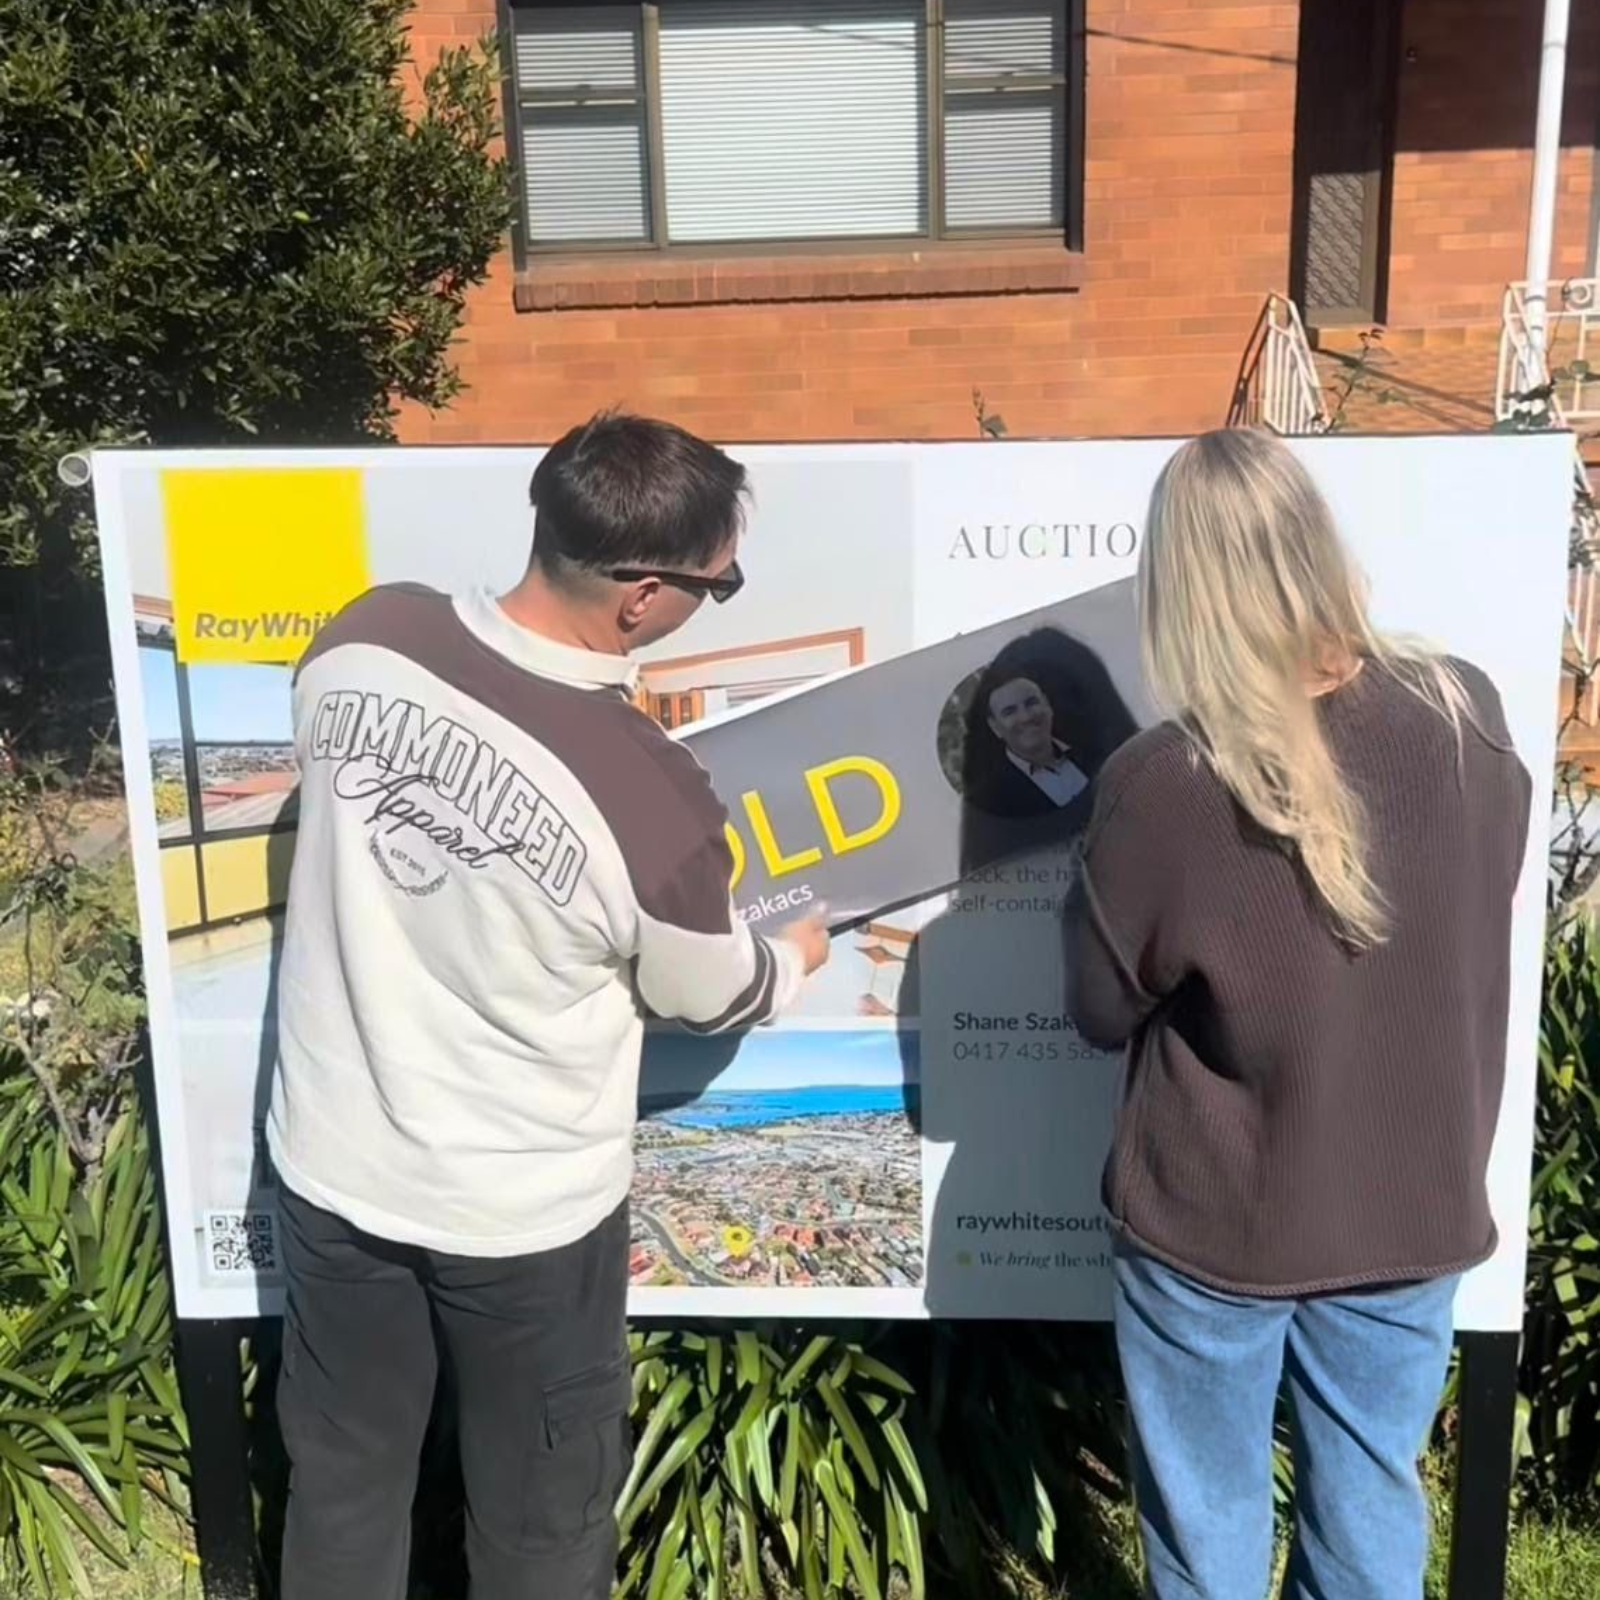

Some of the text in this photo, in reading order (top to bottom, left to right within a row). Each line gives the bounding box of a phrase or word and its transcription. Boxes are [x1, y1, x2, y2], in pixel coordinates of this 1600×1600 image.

[948, 522, 1138, 560] AUCTIO
[333, 752, 524, 869] Apparel
[724, 755, 902, 890] LD
[1017, 864, 1049, 884] the
[735, 883, 815, 923] zakacs
[952, 894, 1060, 913] self-contai
[952, 1011, 1080, 1031] Shane Szak
[953, 1041, 1010, 1061] 0417
[1016, 1041, 1059, 1061] 435
[1007, 1250, 1052, 1269] bring
[1055, 1250, 1081, 1267] the
